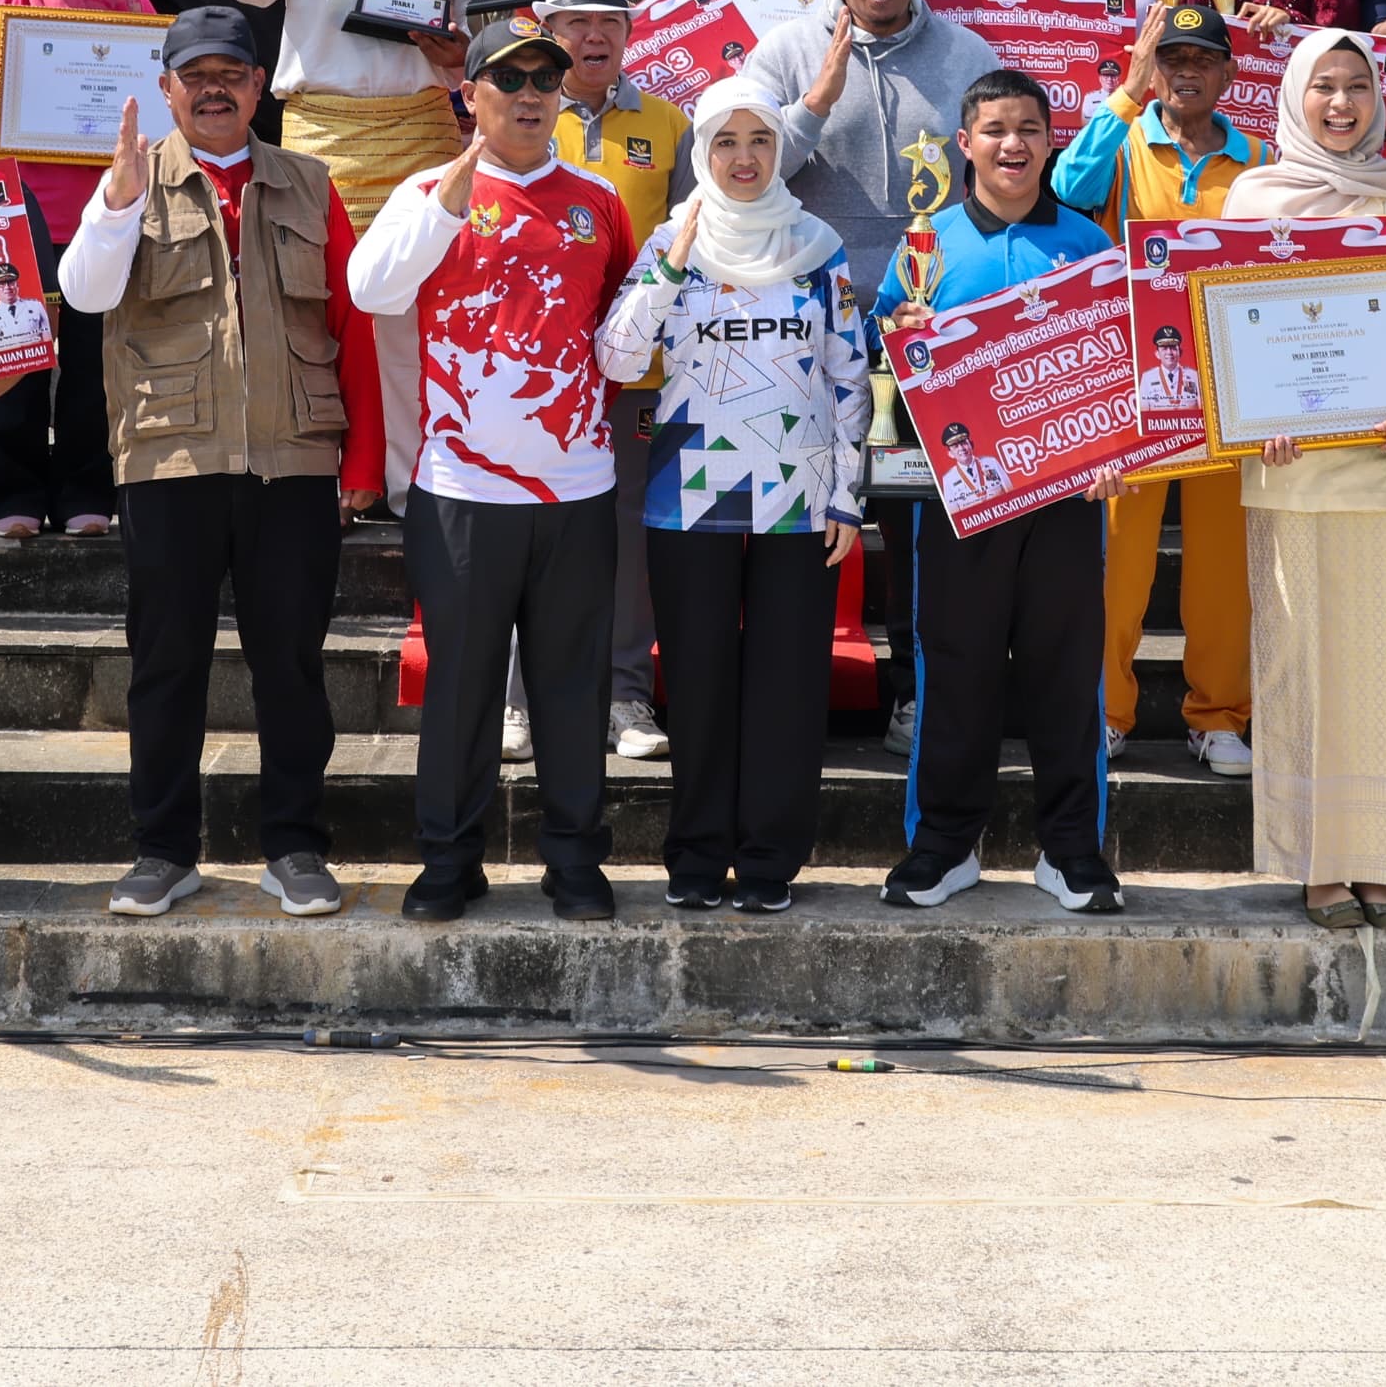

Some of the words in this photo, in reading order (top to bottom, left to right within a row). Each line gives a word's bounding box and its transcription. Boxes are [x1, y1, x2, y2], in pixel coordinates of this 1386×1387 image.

[663, 20, 696, 43] Tahun
[977, 10, 1028, 24] Pancasila
[1031, 16, 1060, 30] Kepri
[1061, 17, 1093, 29] Tahun
[1096, 22, 1119, 32] 2025
[669, 50, 691, 70] 3
[1006, 45, 1027, 54] Baris
[1029, 46, 1065, 57] Berbaris
[1067, 45, 1097, 58] (LKBB)
[1021, 60, 1063, 70] Terfavorit
[668, 71, 706, 99] Pantun
[697, 319, 811, 343] KEPRI
[24, 345, 47, 358] RIAU
[923, 367, 966, 393] Gebyar
[966, 342, 1008, 371] Pelajar
[1009, 317, 1068, 352] Pancasila
[1070, 304, 1101, 330] Kepri
[994, 339, 1102, 398] JUARA
[1104, 329, 1125, 355] 1
[1004, 398, 1047, 424] Lomba
[1050, 381, 1084, 405] Video
[1087, 364, 1132, 393] Pendek
[1148, 418, 1178, 431] BADAN
[962, 505, 993, 530] BADAN
[993, 491, 1036, 518] KESATUAN
[1037, 480, 1071, 502] BANGSA
[1072, 472, 1091, 490] DAN
[1124, 446, 1165, 469] PROVINSI
